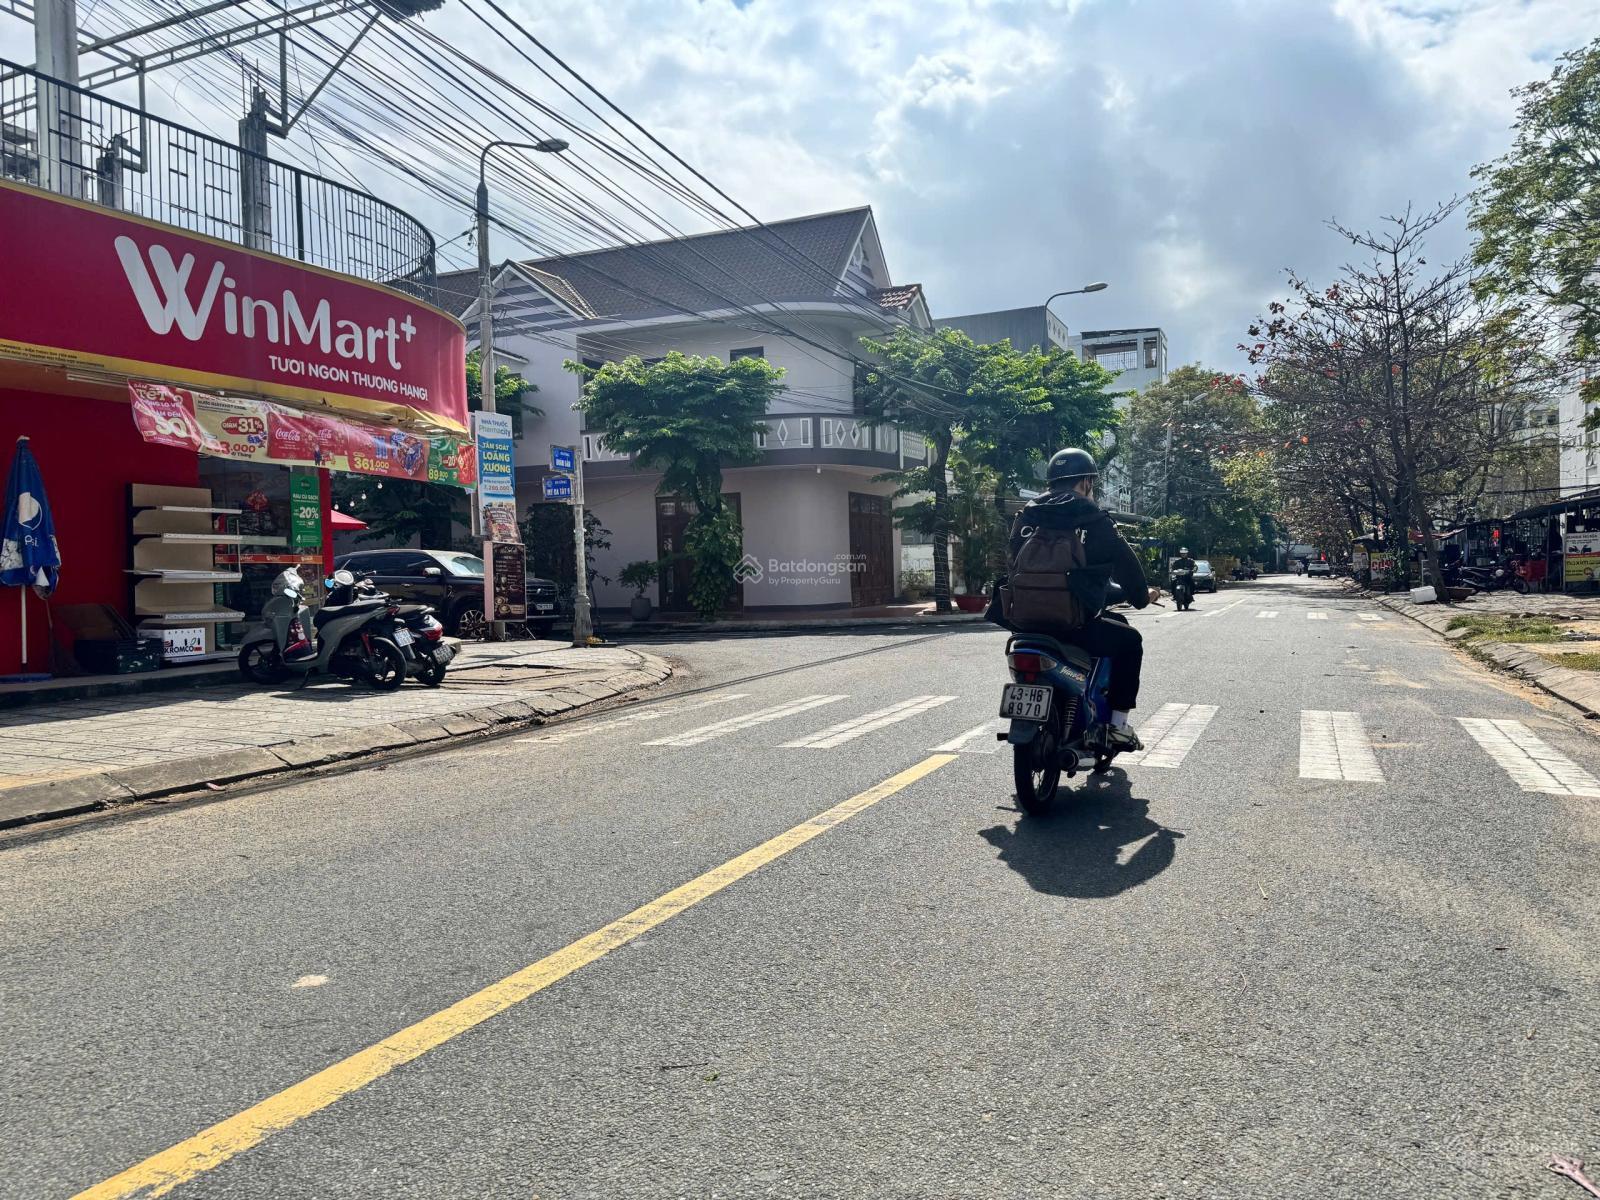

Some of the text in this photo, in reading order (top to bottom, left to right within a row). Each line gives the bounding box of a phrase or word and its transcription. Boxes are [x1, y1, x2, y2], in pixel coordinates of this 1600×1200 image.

[269, 355, 305, 376] TƯƠI
[308, 362, 350, 384] NGON
[237, 417, 263, 433] 31%
[299, 506, 319, 519] 20%
[1008, 702, 1041, 717] 8970
